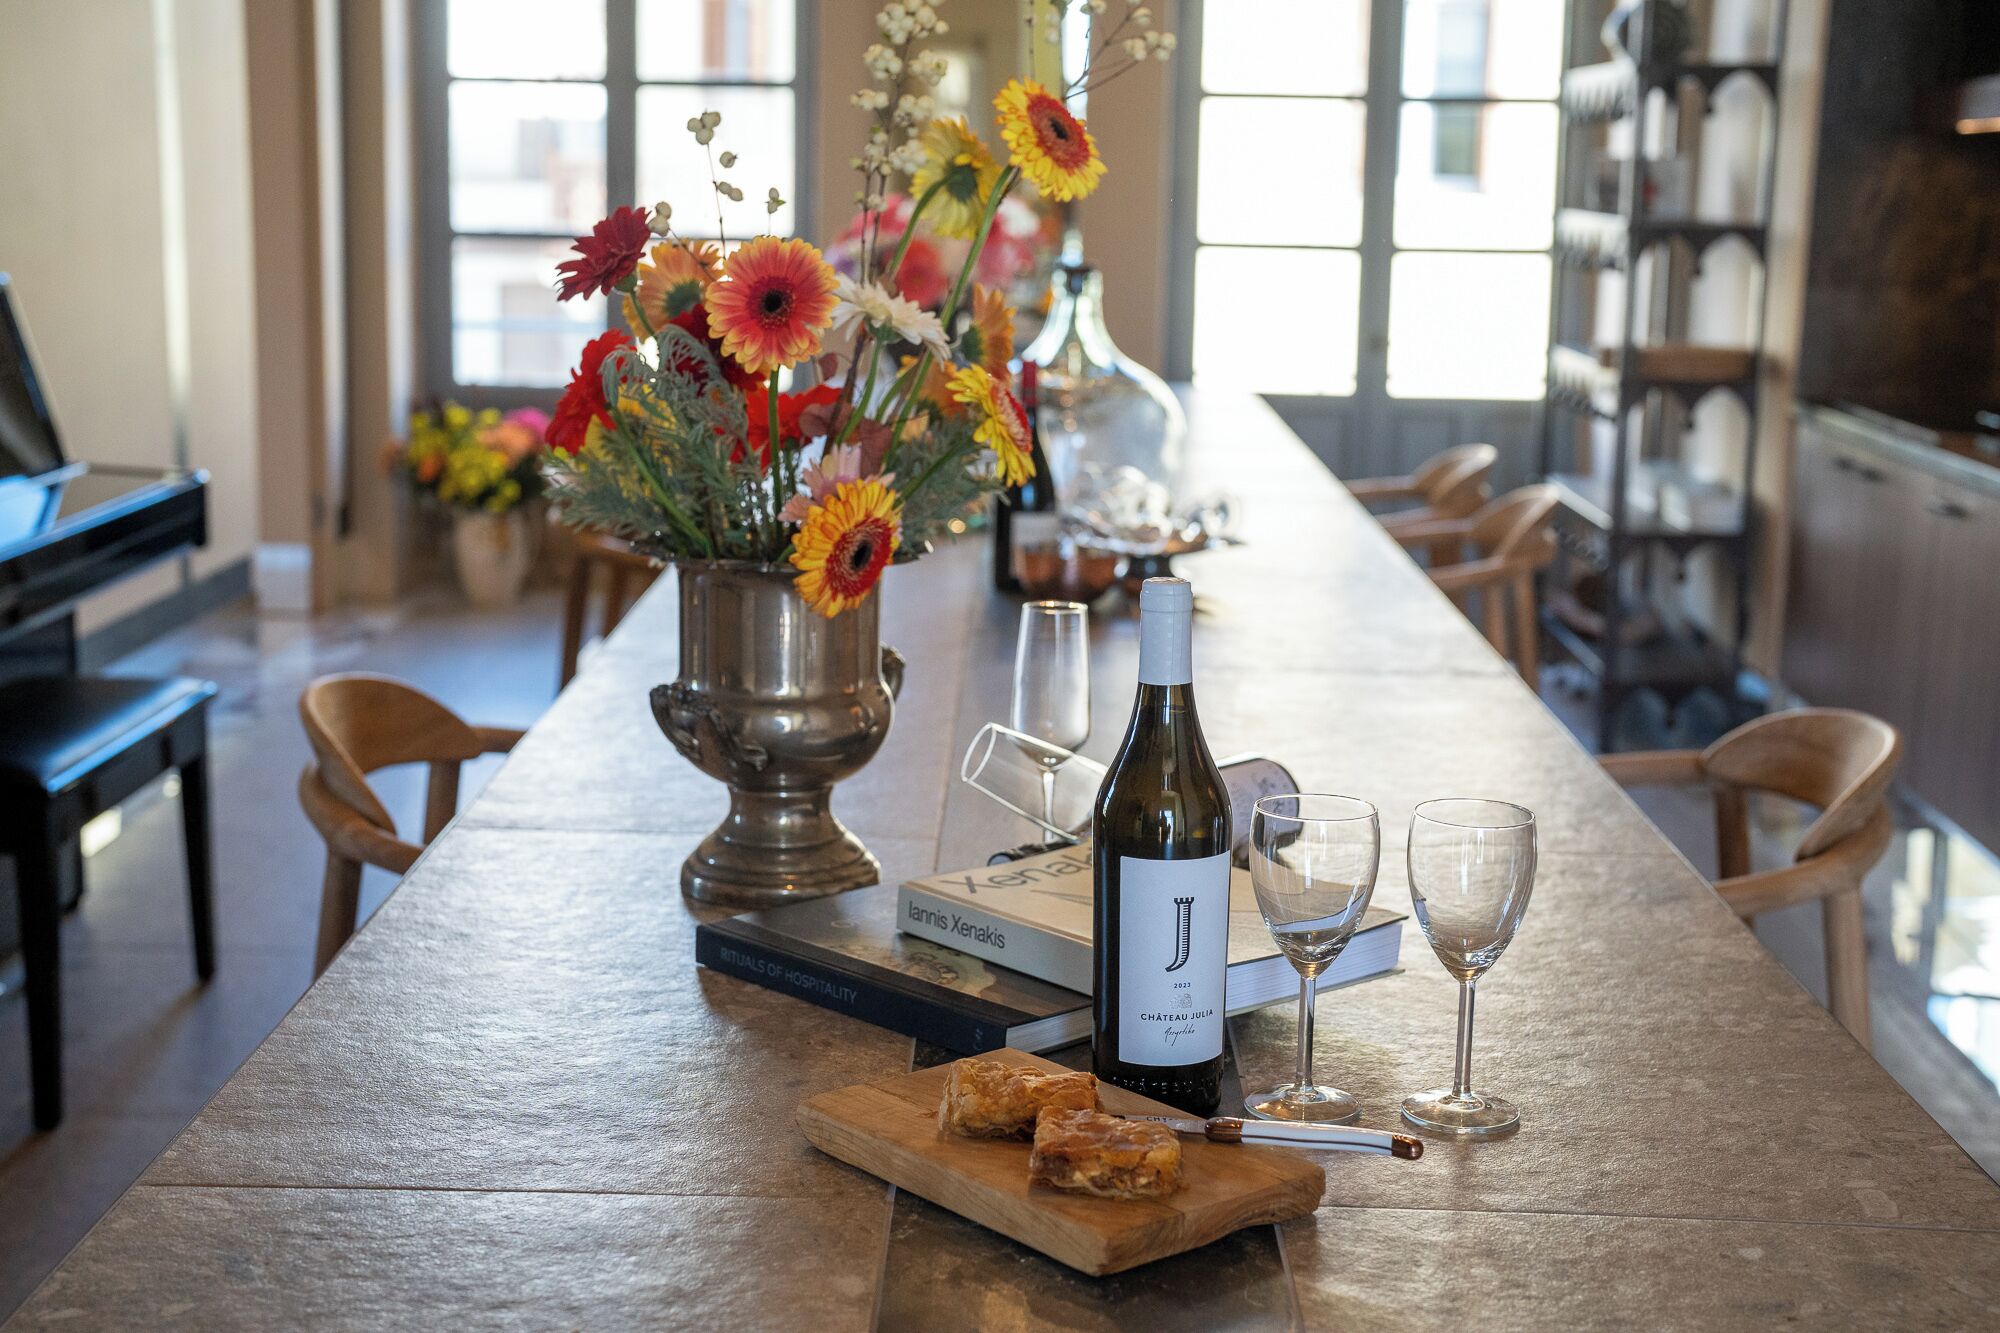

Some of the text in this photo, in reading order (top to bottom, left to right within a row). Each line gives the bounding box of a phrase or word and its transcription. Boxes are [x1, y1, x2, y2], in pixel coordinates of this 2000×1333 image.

[939, 849, 1093, 893] Xenak
[908, 900, 1006, 949] Iannis Xenakis
[720, 947, 857, 1004] RITUALS OF HOSPITALITY
[1140, 1009, 1214, 1021] CHÂTEAU JULIA
